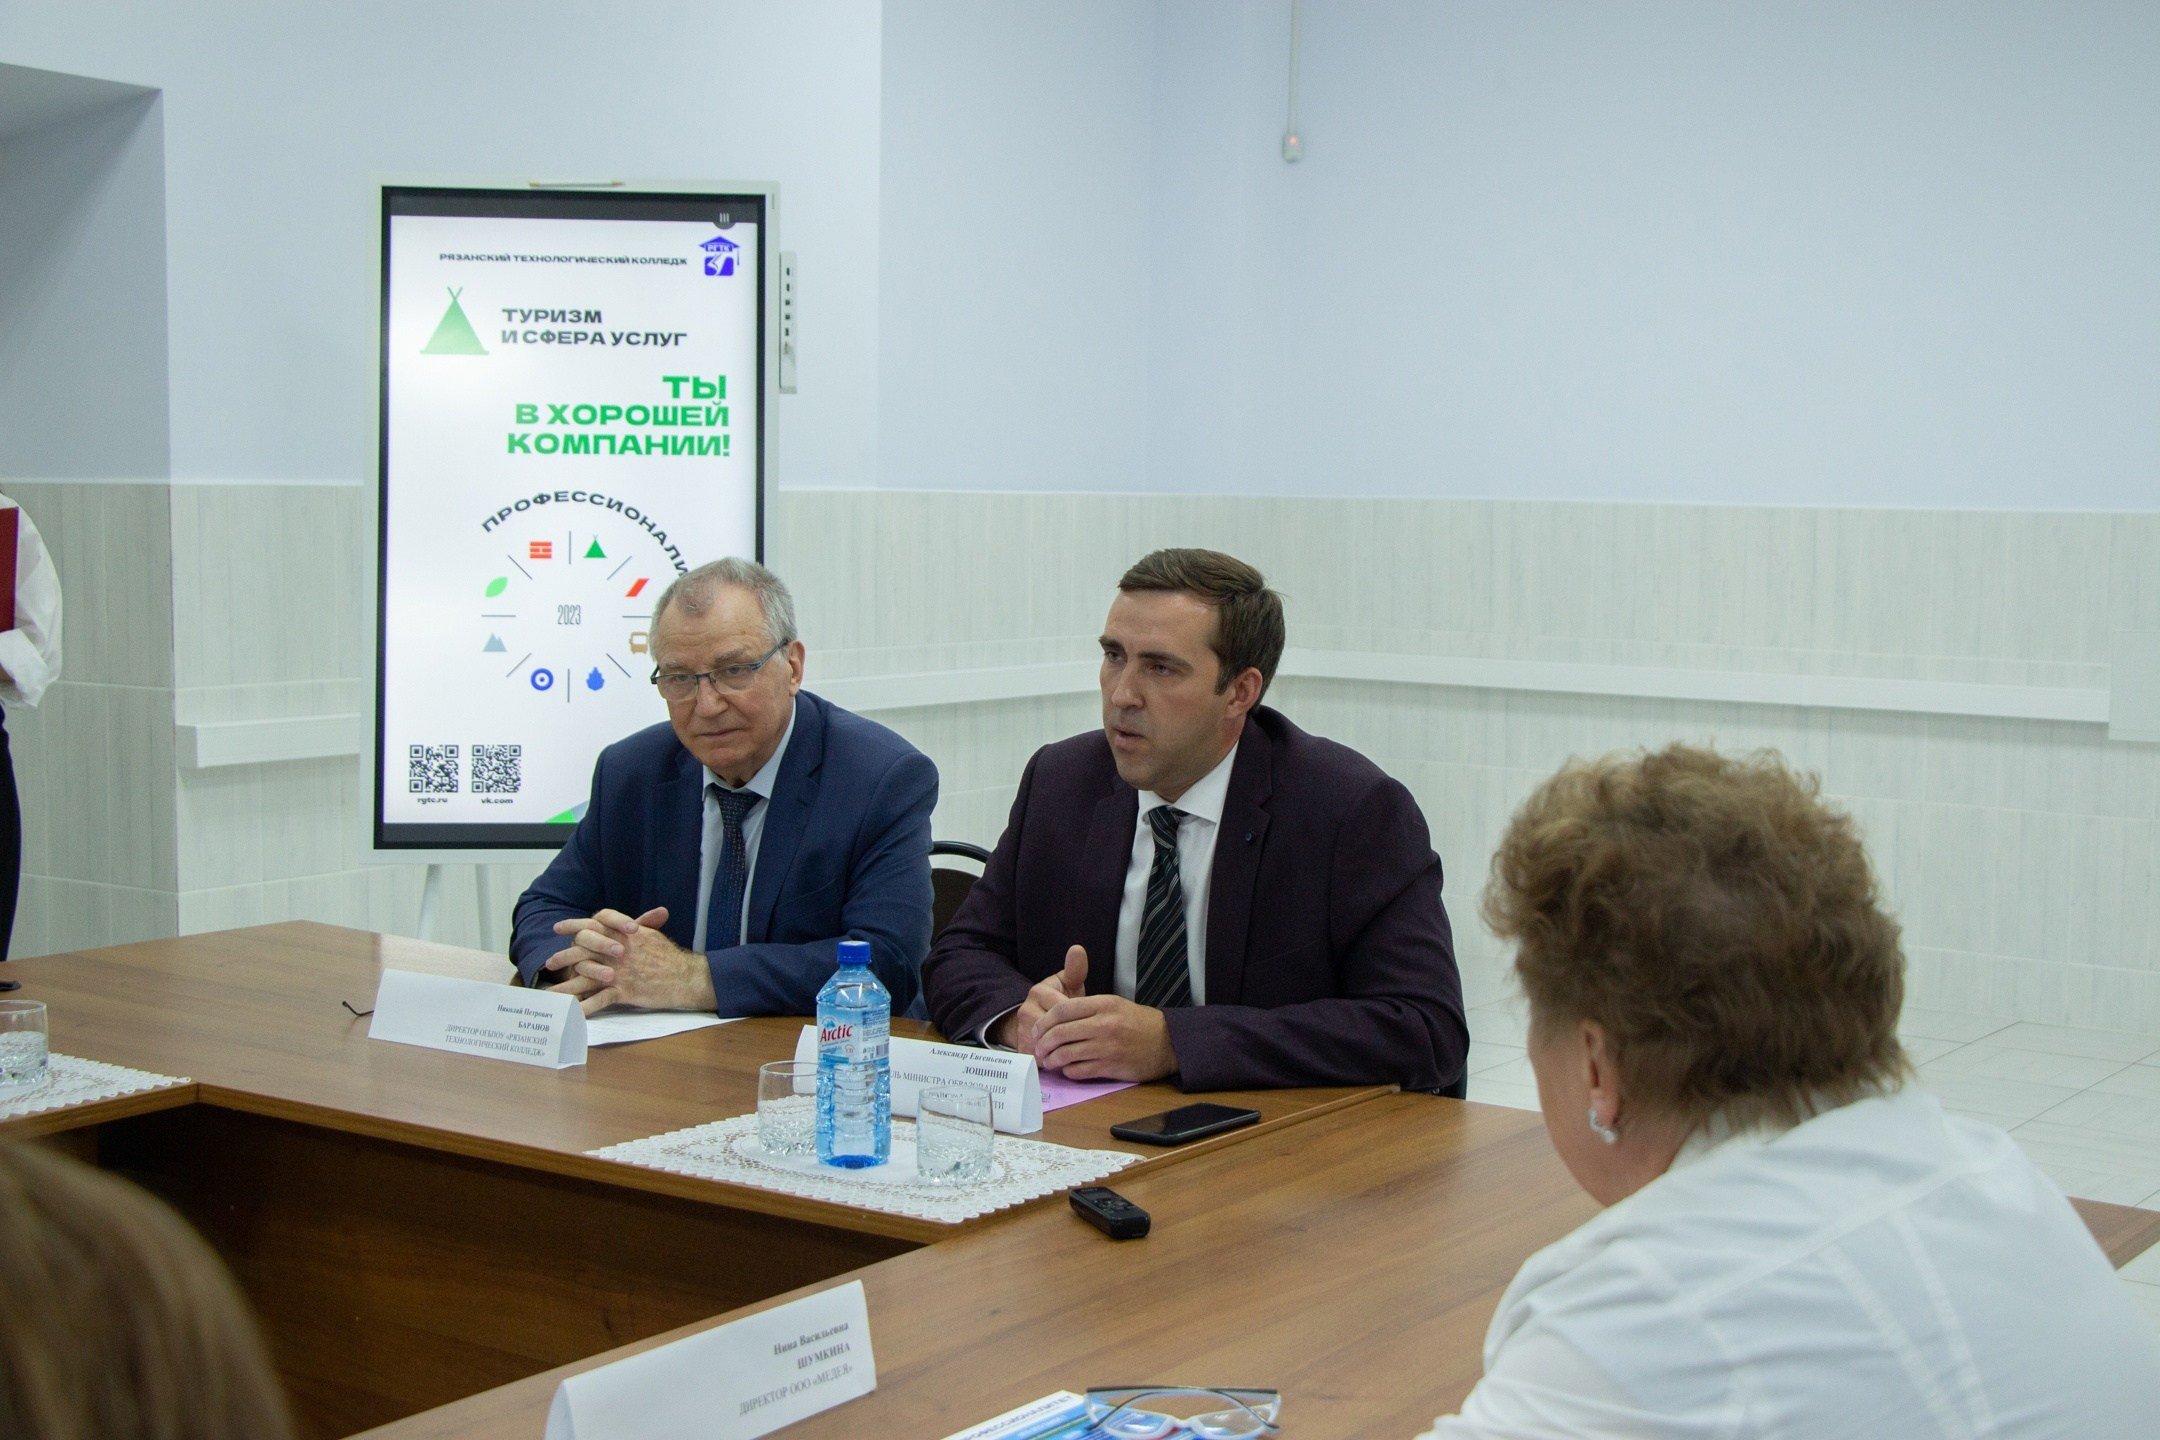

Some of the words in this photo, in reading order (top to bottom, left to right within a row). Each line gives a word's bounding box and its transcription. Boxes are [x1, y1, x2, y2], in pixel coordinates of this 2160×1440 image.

[440, 253, 510, 262] РЯЗАНСКИЙ
[514, 255, 629, 264] ТЕХНОЛОГИЧЕСКИЙ
[632, 256, 688, 265] КОЛЛЕДЖ
[502, 308, 602, 323] ТУРИЗМ
[502, 330, 517, 344] И
[523, 330, 606, 345] СФЕРА
[611, 332, 687, 346] УСЛУГ
[662, 375, 726, 399] ТЫ
[516, 403, 539, 425] В
[547, 401, 729, 427] ХОРОШЕЙ
[507, 433, 730, 457] КОМПАНИИ!
[557, 604, 581, 625] 2023
[497, 1004, 523, 1015] Николай
[524, 1008, 553, 1019] Петрович
[445, 1024, 479, 1035] ДИРЕКТОР
[506, 1033, 548, 1046] «РЯЗАНСКИЙ
[518, 1021, 550, 1032] БАРАНОВ
[820, 1024, 853, 1042] Arctic
[445, 1035, 510, 1052] ТЕХНОЛОГИЧЕСКИЙ
[930, 1048, 968, 1060] Александр
[969, 1052, 1012, 1065] Евгеньевич
[902, 1072, 946, 1086] МИНИСТРА
[962, 1066, 1008, 1080] ЛОЩИНИН
[774, 1341, 797, 1355] Нина
[799, 1322, 849, 1346] Васильевна
[797, 1342, 851, 1369] ШУМКИНА
[739, 1386, 788, 1416] ДИРЕКТОР
[790, 1378, 811, 1395] ООО
